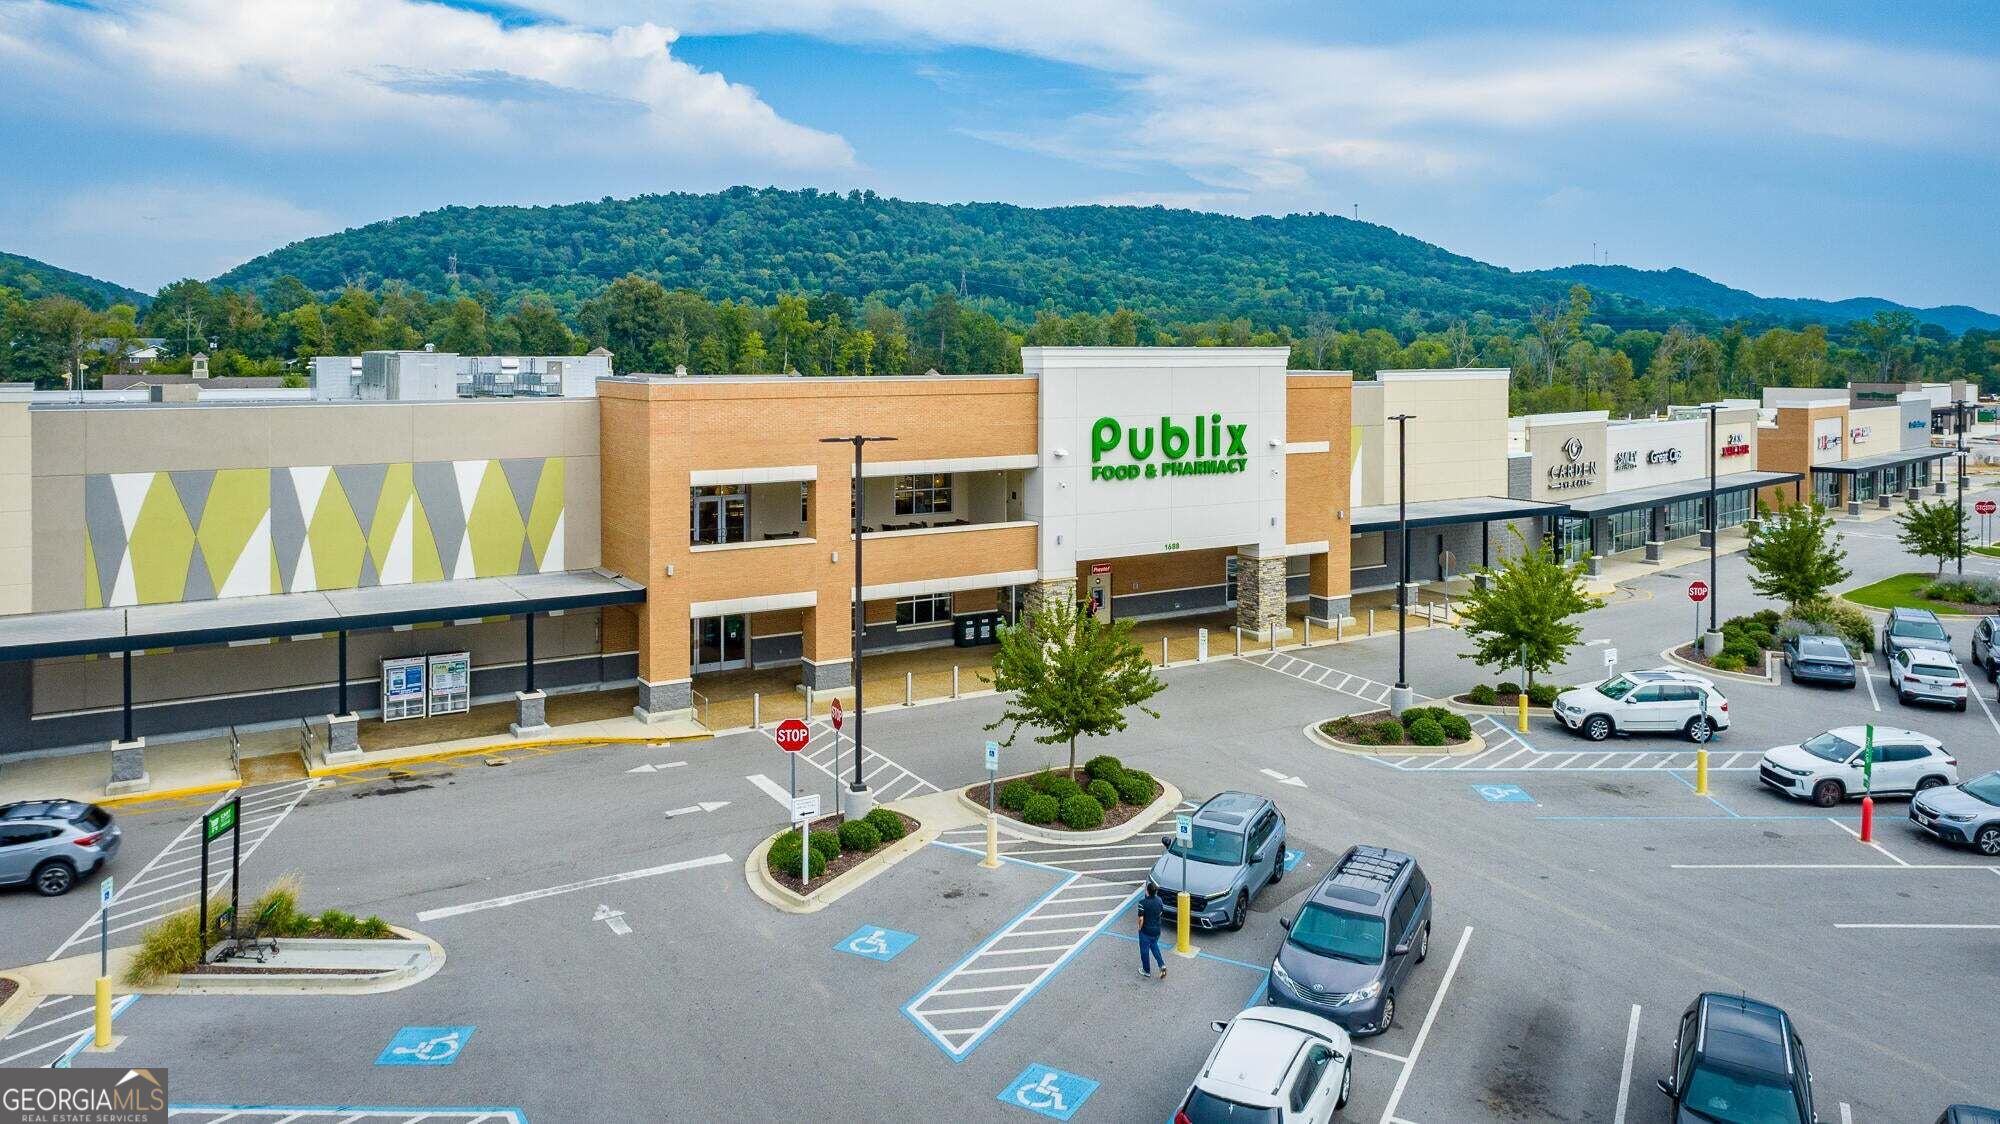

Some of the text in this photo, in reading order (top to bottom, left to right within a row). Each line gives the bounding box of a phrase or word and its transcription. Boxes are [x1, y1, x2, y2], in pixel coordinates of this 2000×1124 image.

[1092, 413, 1248, 463] Publix
[1092, 458, 1248, 482] FOOD & PHARMACY
[1690, 587, 1708, 596] STOP
[778, 729, 808, 743] STOP
